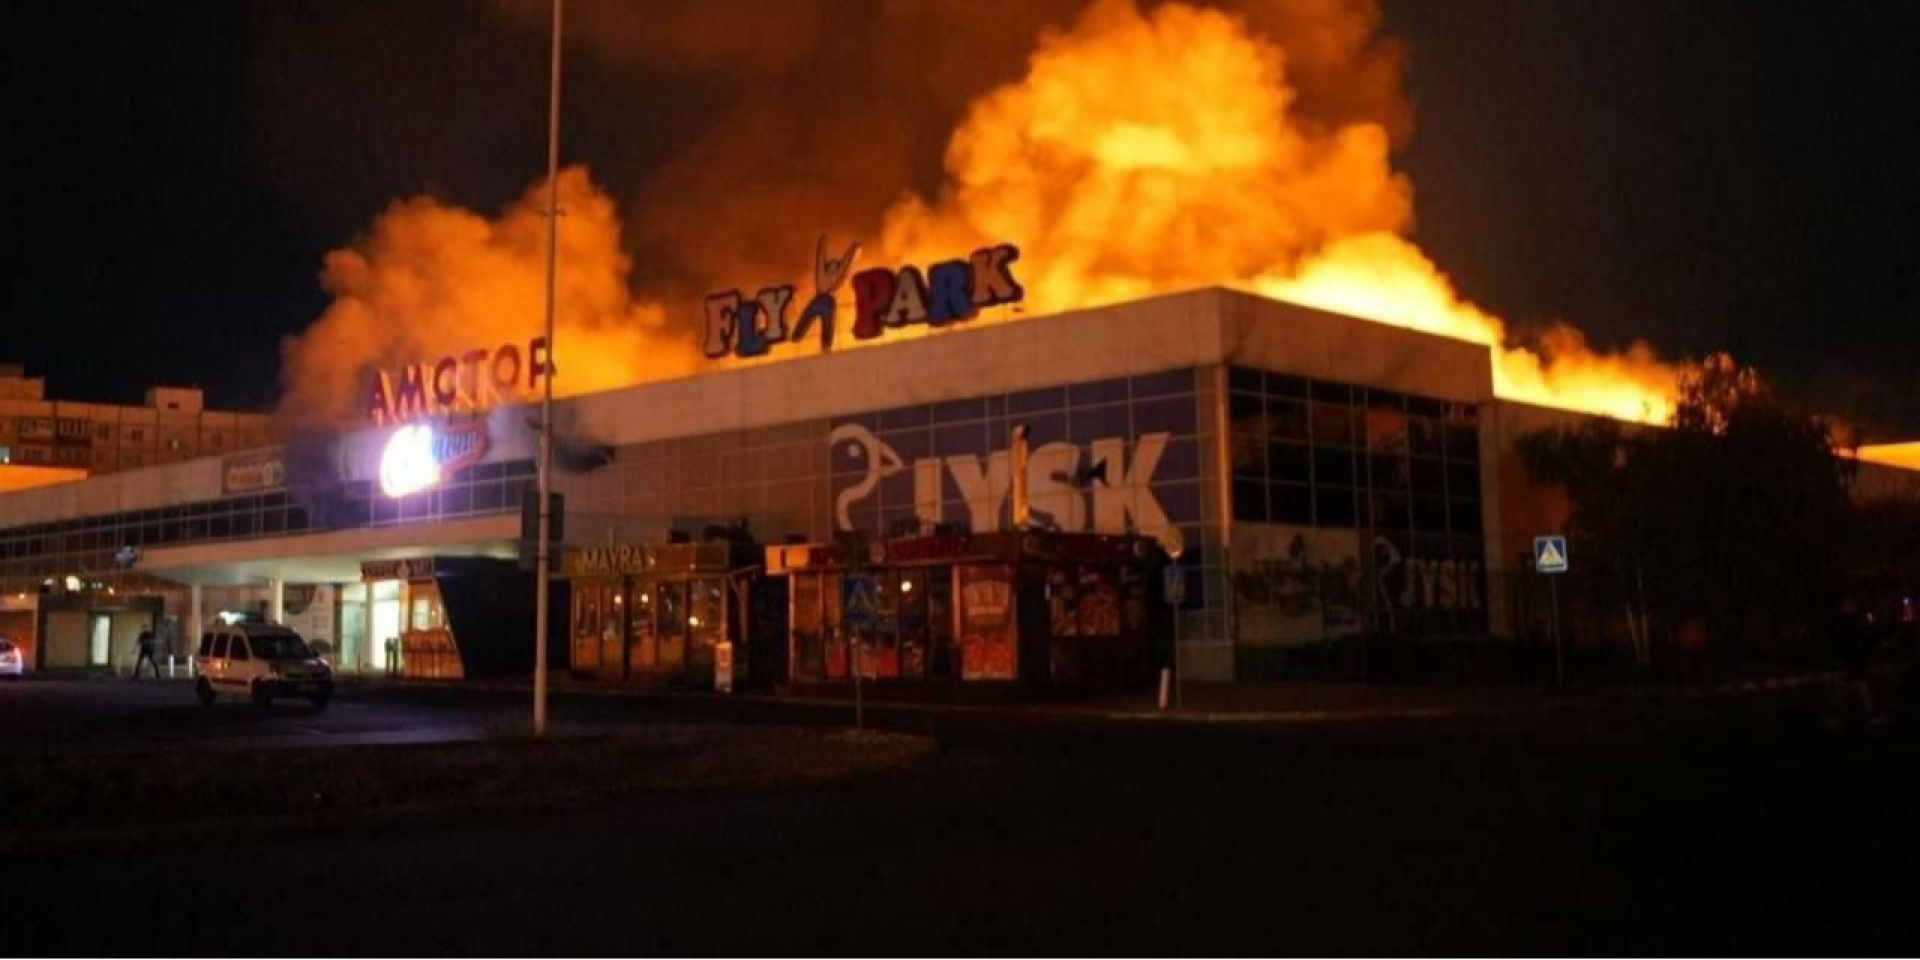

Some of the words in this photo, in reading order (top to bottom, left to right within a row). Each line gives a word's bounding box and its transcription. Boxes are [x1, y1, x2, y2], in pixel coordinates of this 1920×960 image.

[705, 286, 794, 359] FLY
[854, 243, 1022, 339] PARK
[1401, 557, 1481, 608] JYSK
